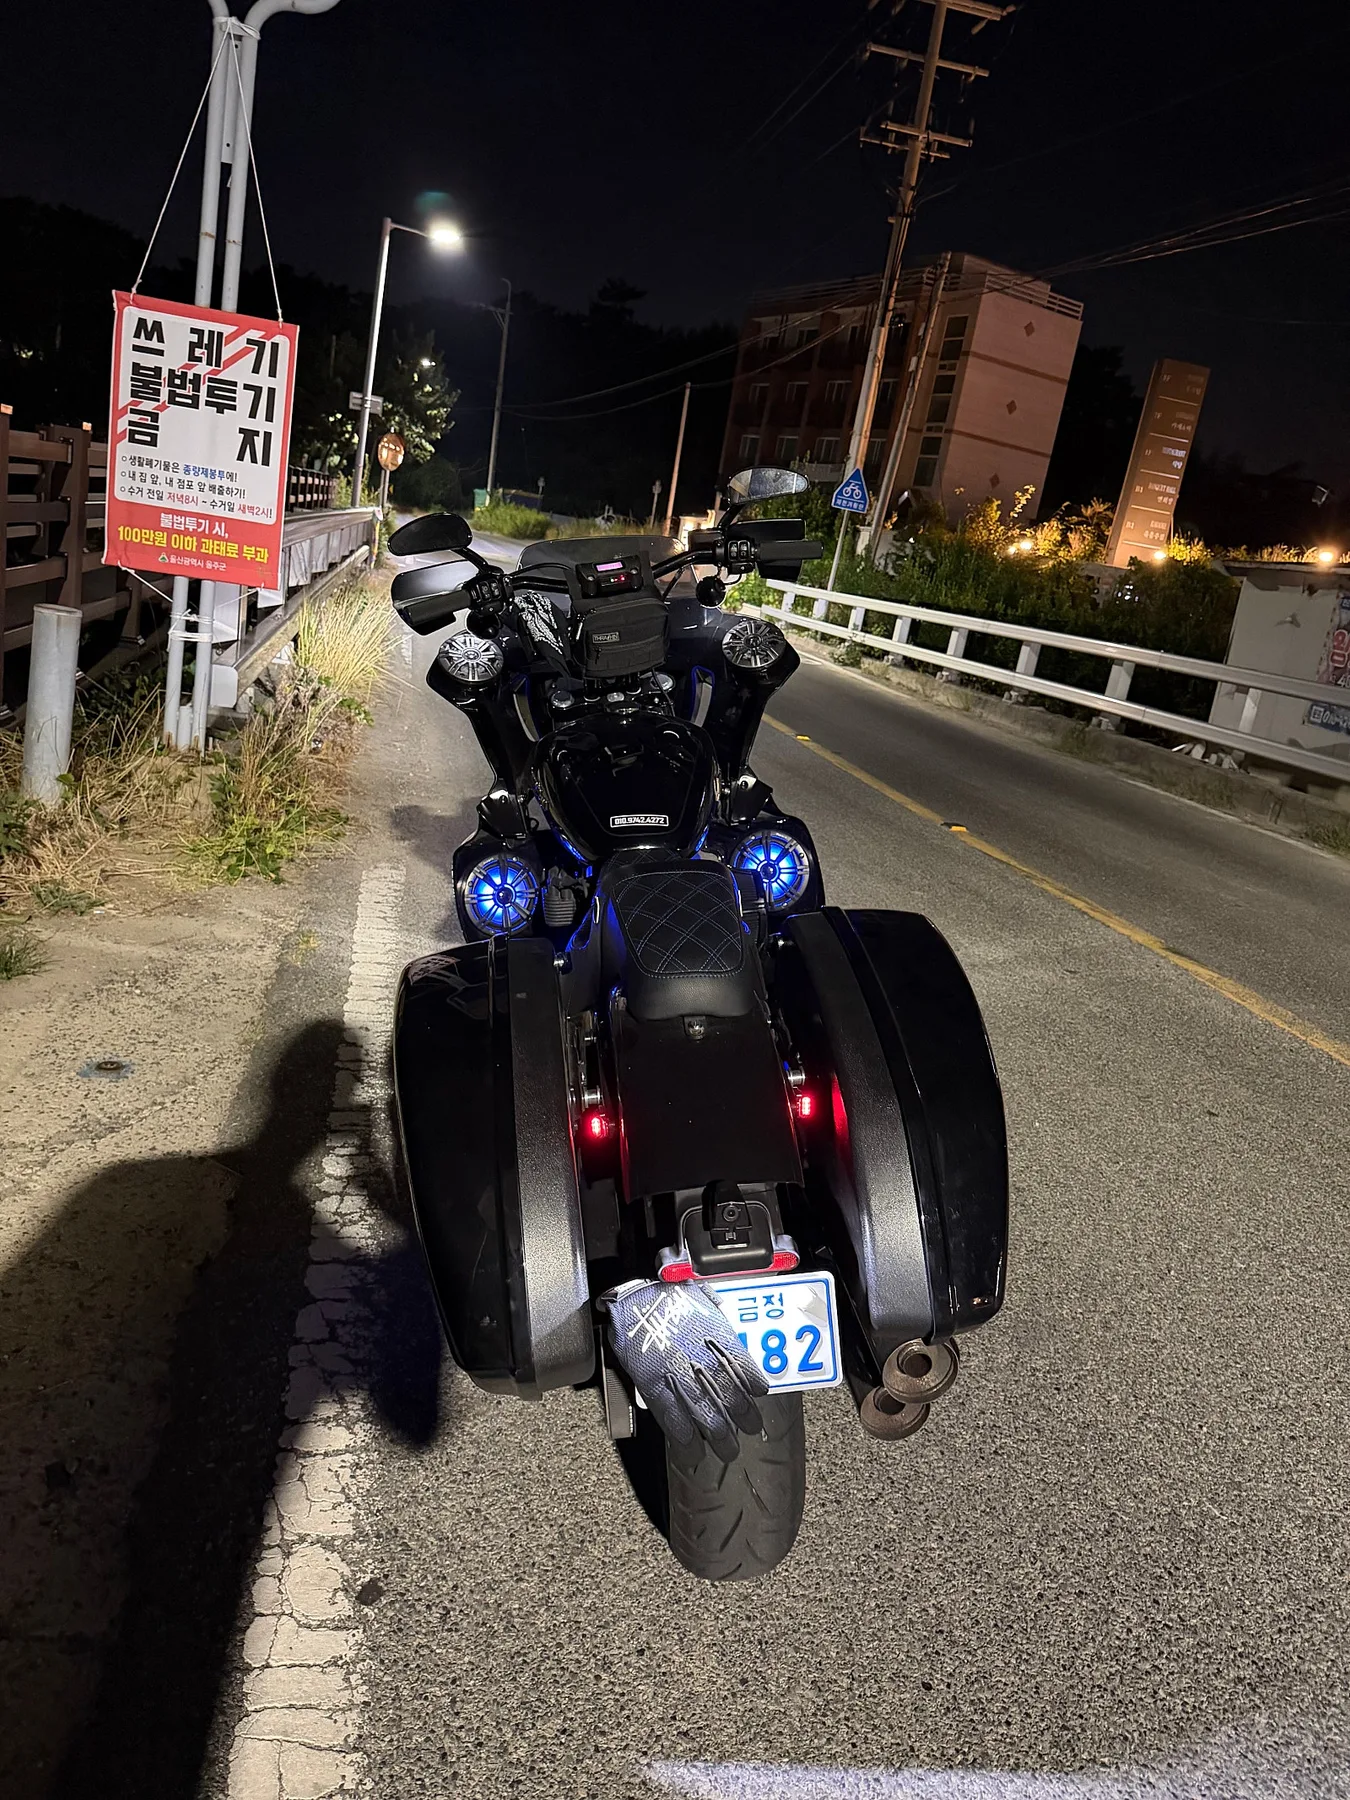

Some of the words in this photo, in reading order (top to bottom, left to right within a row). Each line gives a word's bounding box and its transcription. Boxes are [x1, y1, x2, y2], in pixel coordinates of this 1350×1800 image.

[129, 361, 278, 424] 불법투기
[128, 454, 180, 474] 생활폐기물은
[183, 463, 238, 482] 종량제봉투에!
[128, 470, 136, 481] 내
[138, 471, 147, 483] 집
[165, 476, 174, 488] 내
[176, 478, 194, 490] 점포
[197, 481, 206, 493] 앞
[208, 482, 246, 499] 배출하기!
[127, 485, 144, 498] 수거
[146, 488, 164, 501] 전일
[167, 492, 199, 506] 저녁8시
[209, 499, 235, 513] 수거일
[237, 503, 273, 519] 새벽2시!
[160, 512, 209, 534] 불법투기
[212, 521, 229, 539] 시,
[118, 525, 167, 547] 100만원
[171, 533, 198, 551] 이하
[200, 538, 239, 559] 과태료
[242, 545, 269, 563] 부과
[738, 1291, 785, 1322] 금정
